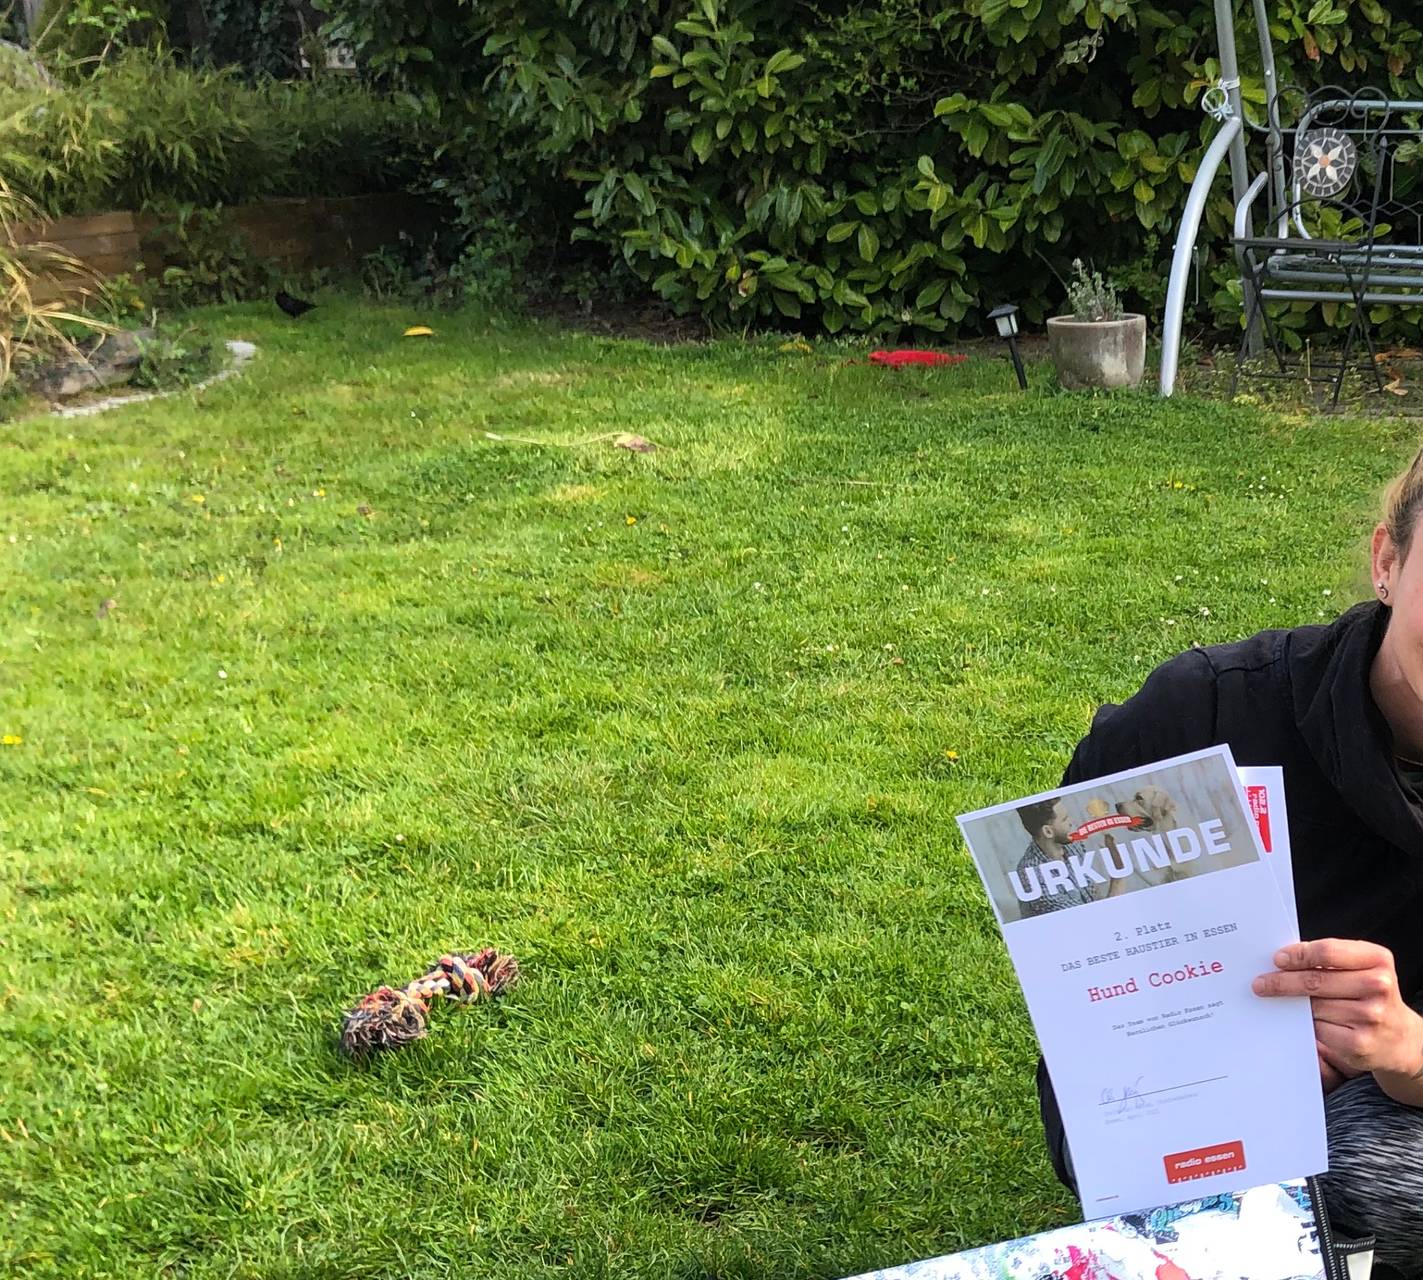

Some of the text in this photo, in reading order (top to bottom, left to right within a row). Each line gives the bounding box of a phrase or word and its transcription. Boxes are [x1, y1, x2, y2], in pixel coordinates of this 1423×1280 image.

[1008, 818, 1232, 902] URKUNDE
[1061, 922, 1238, 972] DAS BESTE HAUSTIER IN ESSEN
[1113, 920, 1172, 942] 2. Platz
[1087, 958, 1225, 1003] Hund Cookie
[1174, 1151, 1235, 1170] radio essen
